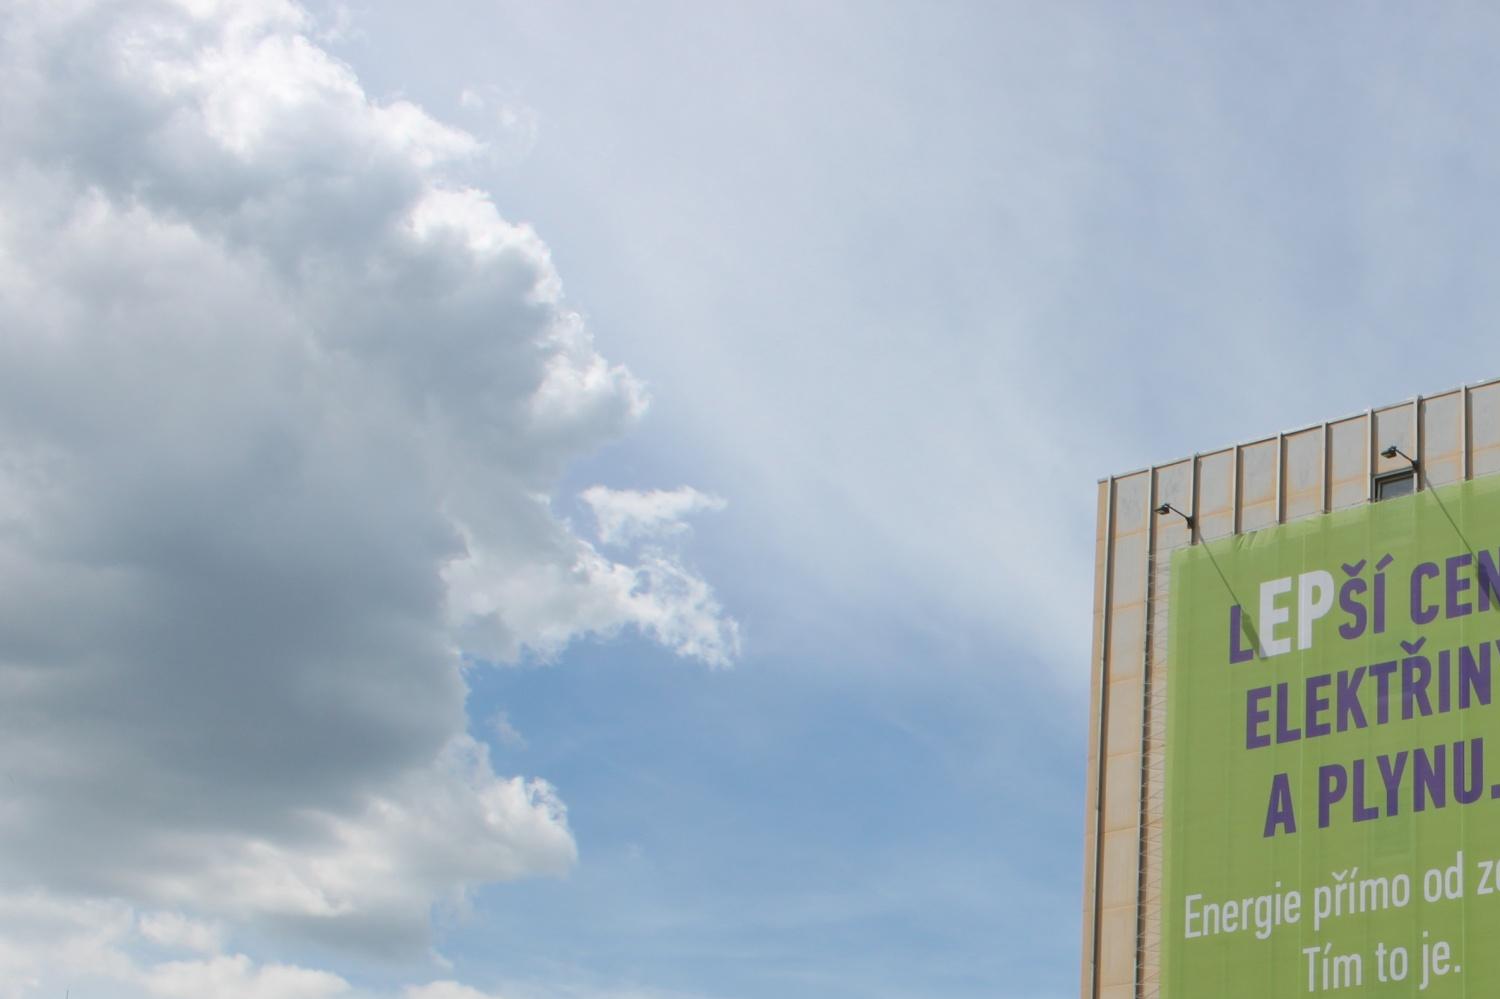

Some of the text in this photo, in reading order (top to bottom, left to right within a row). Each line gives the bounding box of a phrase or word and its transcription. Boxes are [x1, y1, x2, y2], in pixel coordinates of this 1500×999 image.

[1229, 553, 1394, 665] LEPŠÍ
[1263, 772, 1297, 838] A
[1184, 881, 1301, 940] Energie
[1314, 867, 1410, 931] přímo
[1423, 850, 1463, 903] od
[1302, 930, 1461, 992] Tím to je.
